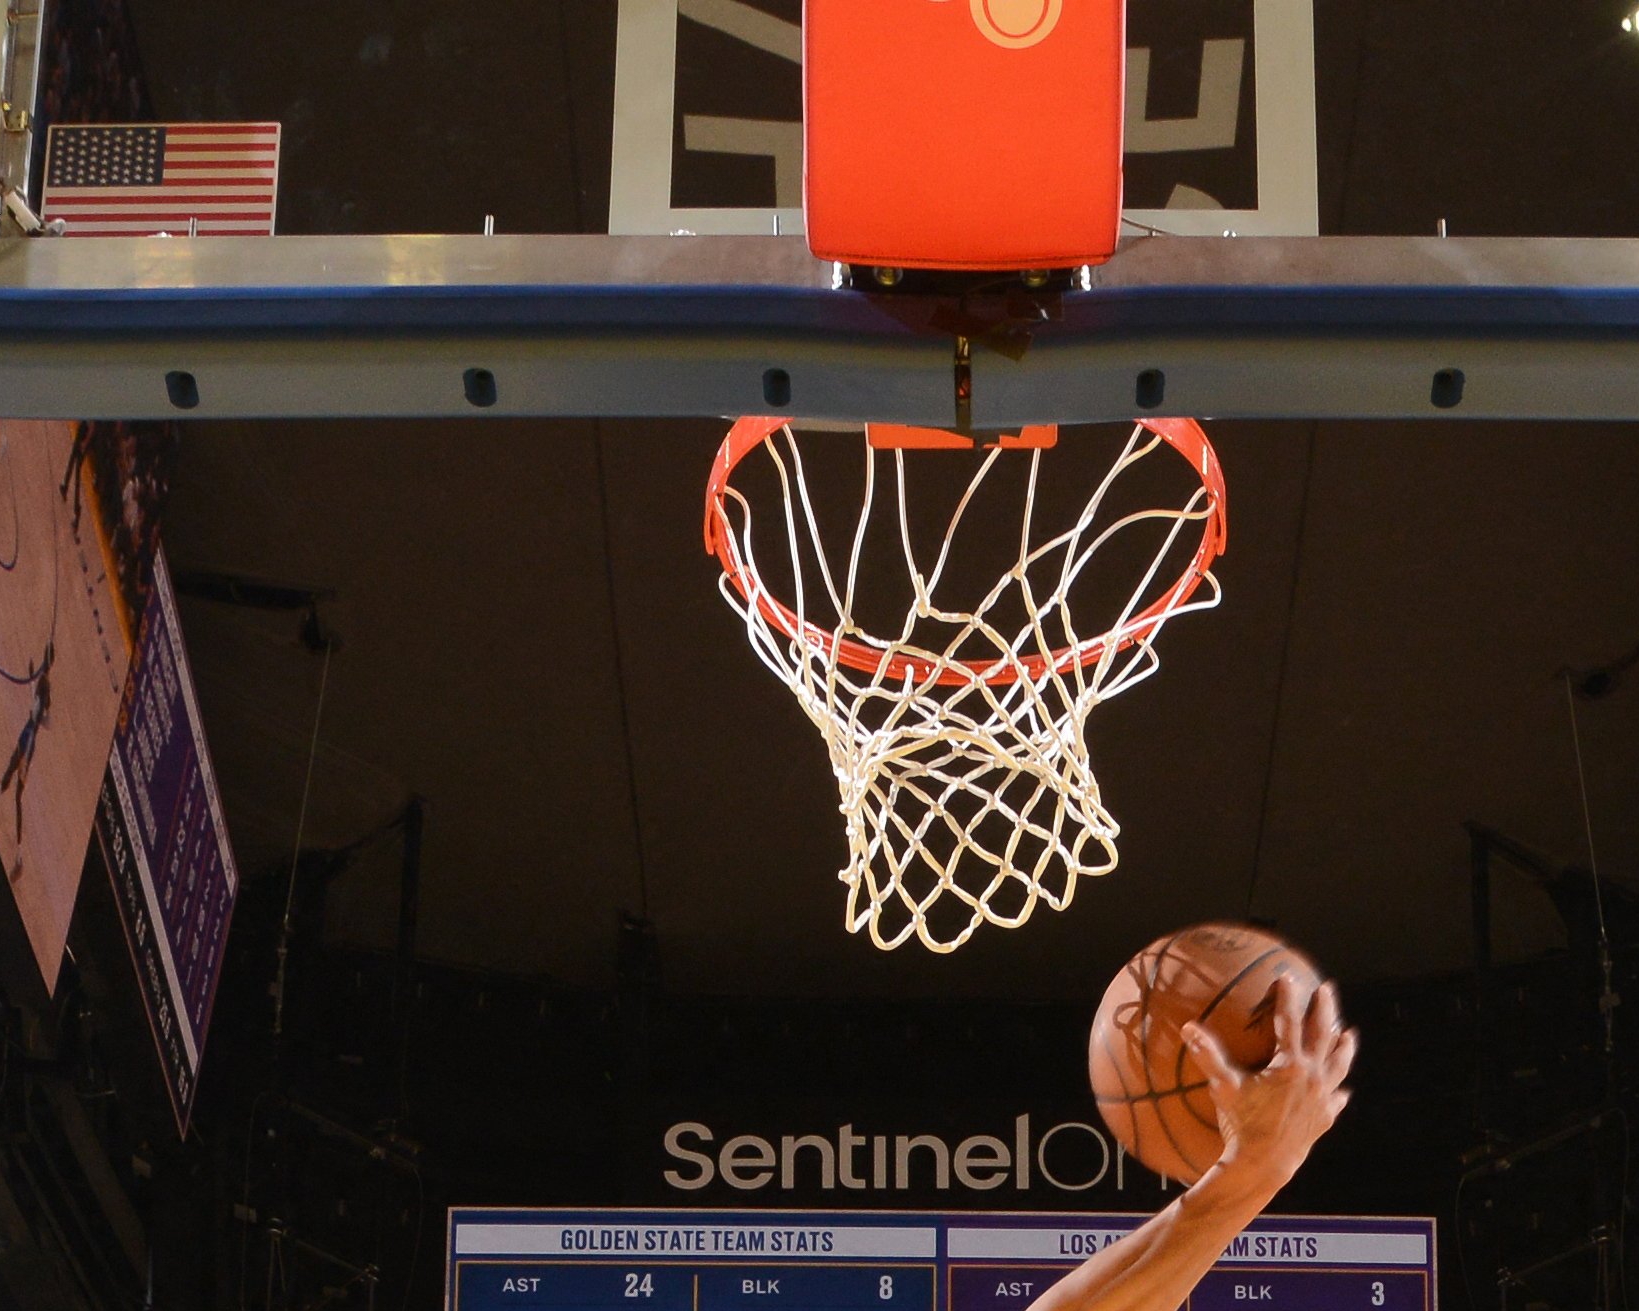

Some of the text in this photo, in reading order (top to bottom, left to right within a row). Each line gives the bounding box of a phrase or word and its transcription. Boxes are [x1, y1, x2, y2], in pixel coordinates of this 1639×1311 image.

[663, 1113, 1170, 1190] SentinelO
[561, 1229, 834, 1253] GOLDEN STATE TEAM STATS
[1059, 1235, 1098, 1255] LOS
[1255, 1238, 1318, 1258] STATS
[502, 1274, 654, 1298] AST 24
[742, 1276, 893, 1299] BLK 8
[995, 1283, 1033, 1297] AST
[1235, 1282, 1385, 1306] BLK 3
